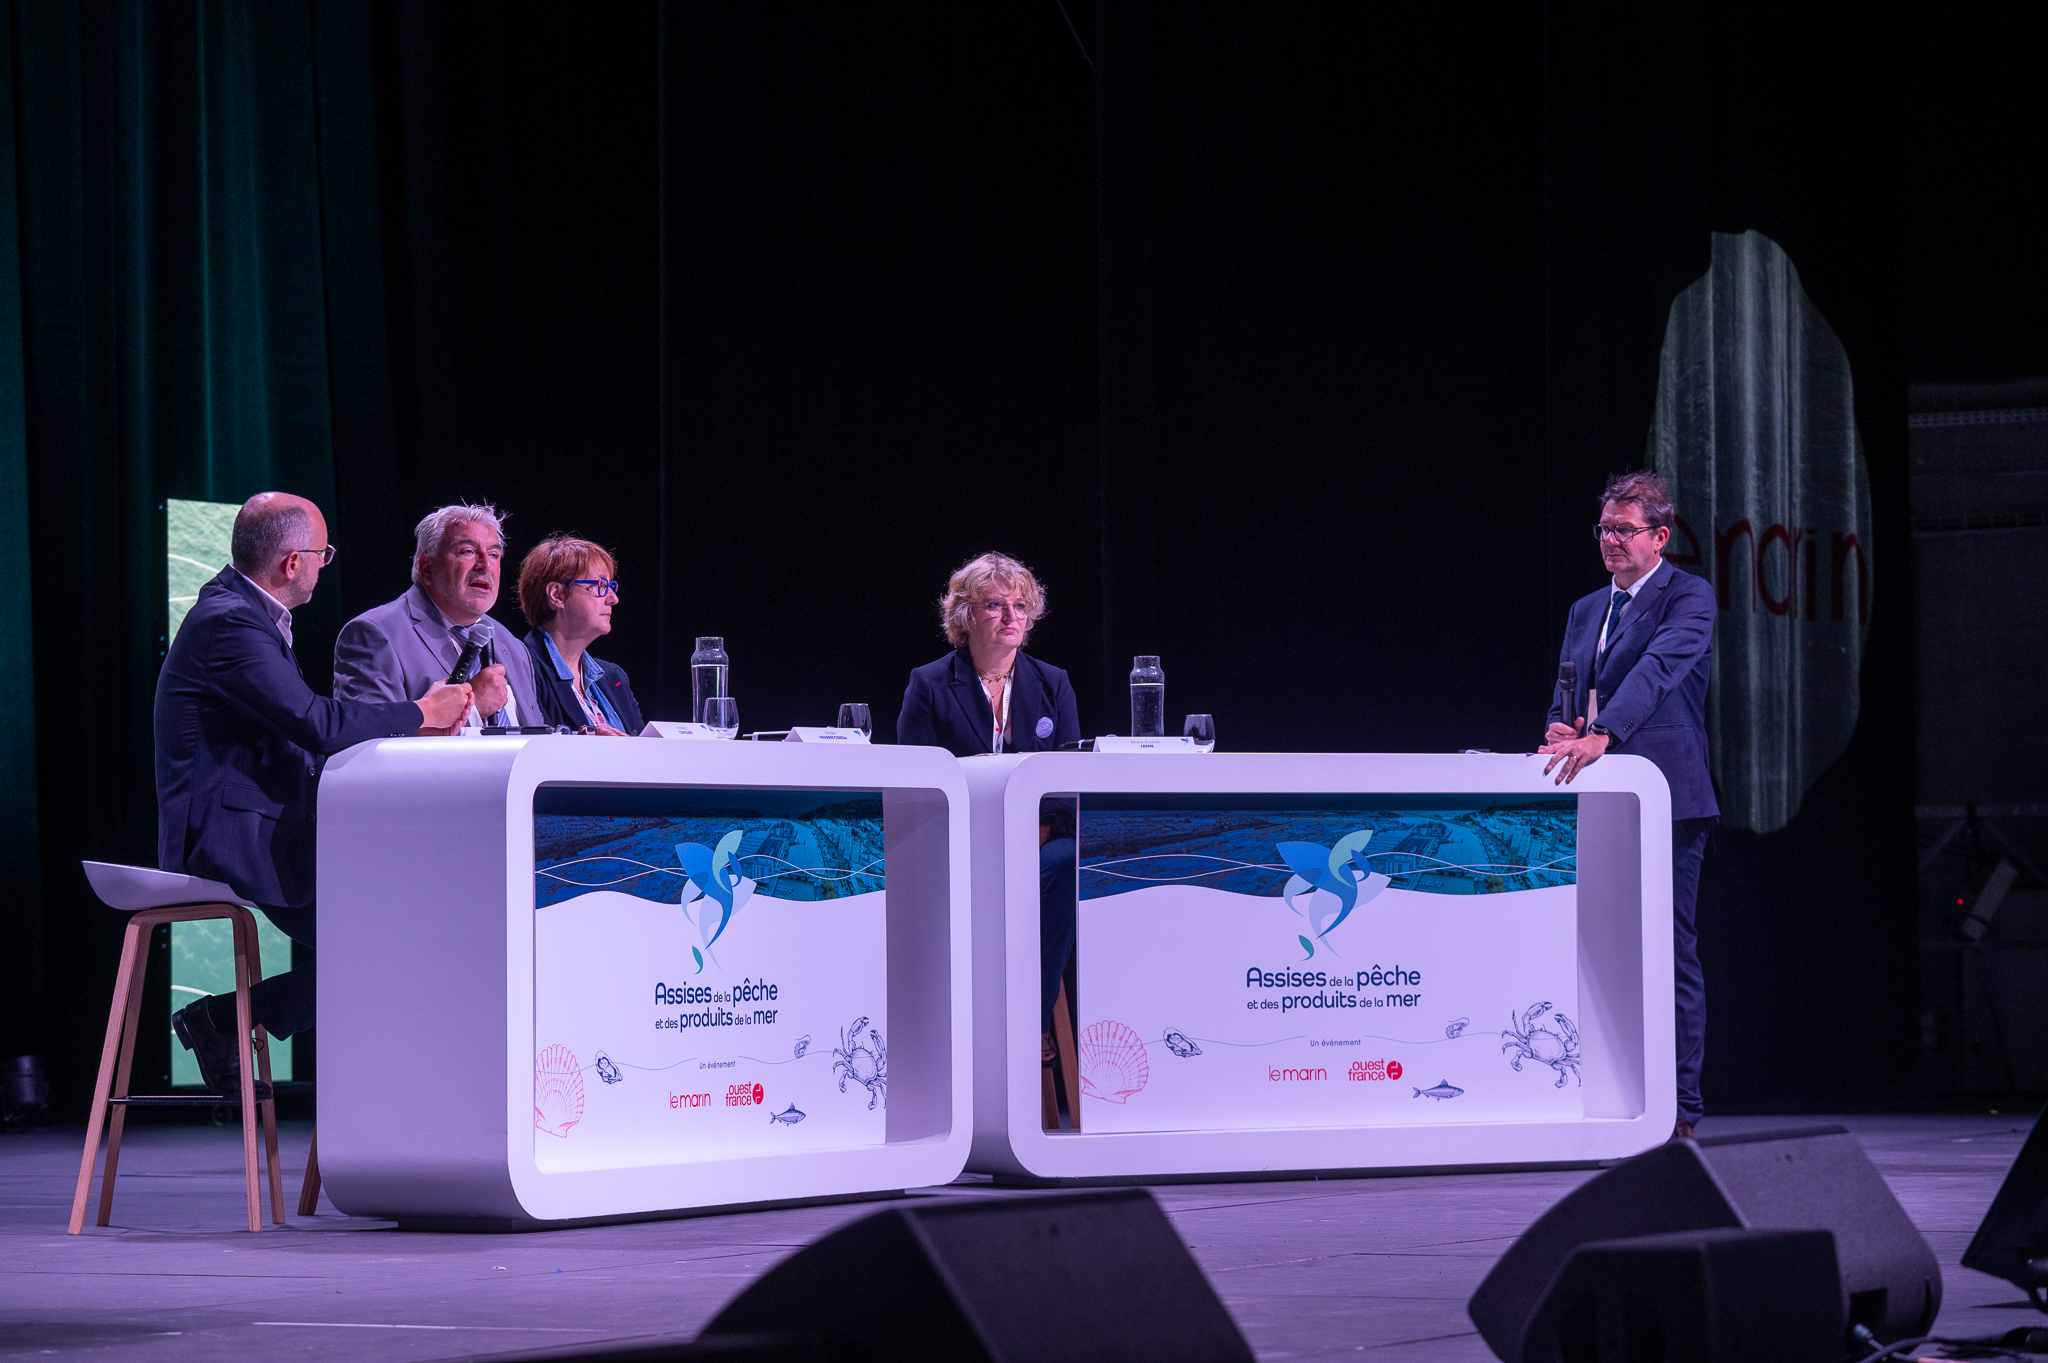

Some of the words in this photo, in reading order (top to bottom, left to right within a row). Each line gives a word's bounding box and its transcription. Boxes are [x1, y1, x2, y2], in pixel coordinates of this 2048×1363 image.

[1246, 966, 1327, 988] Assises
[1329, 975, 1343, 987] de
[1344, 975, 1354, 987] la
[1356, 963, 1421, 992] pêche
[655, 981, 712, 1006] Assises
[713, 990, 723, 1003] de
[724, 990, 731, 1003] la
[732, 977, 778, 1008] pêche
[1246, 999, 1259, 1010] et
[1260, 998, 1279, 1010] des
[1281, 989, 1357, 1014] produits
[1359, 996, 1373, 1008] de
[1374, 996, 1384, 1008] la
[1386, 993, 1421, 1007] mer
[655, 1018, 664, 1030] et
[664, 1017, 679, 1030] des
[679, 1006, 734, 1034] produits
[734, 1013, 744, 1026] de
[744, 1013, 752, 1026] la
[753, 1009, 778, 1025] mer
[1309, 1039, 1320, 1047] Un
[1321, 1038, 1362, 1047] événement
[699, 1062, 707, 1070] Un
[707, 1060, 736, 1069] événement
[1351, 1058, 1386, 1071] ouest
[1347, 1068, 1386, 1082] france
[728, 1081, 752, 1095] ouest
[725, 1093, 752, 1107] france
